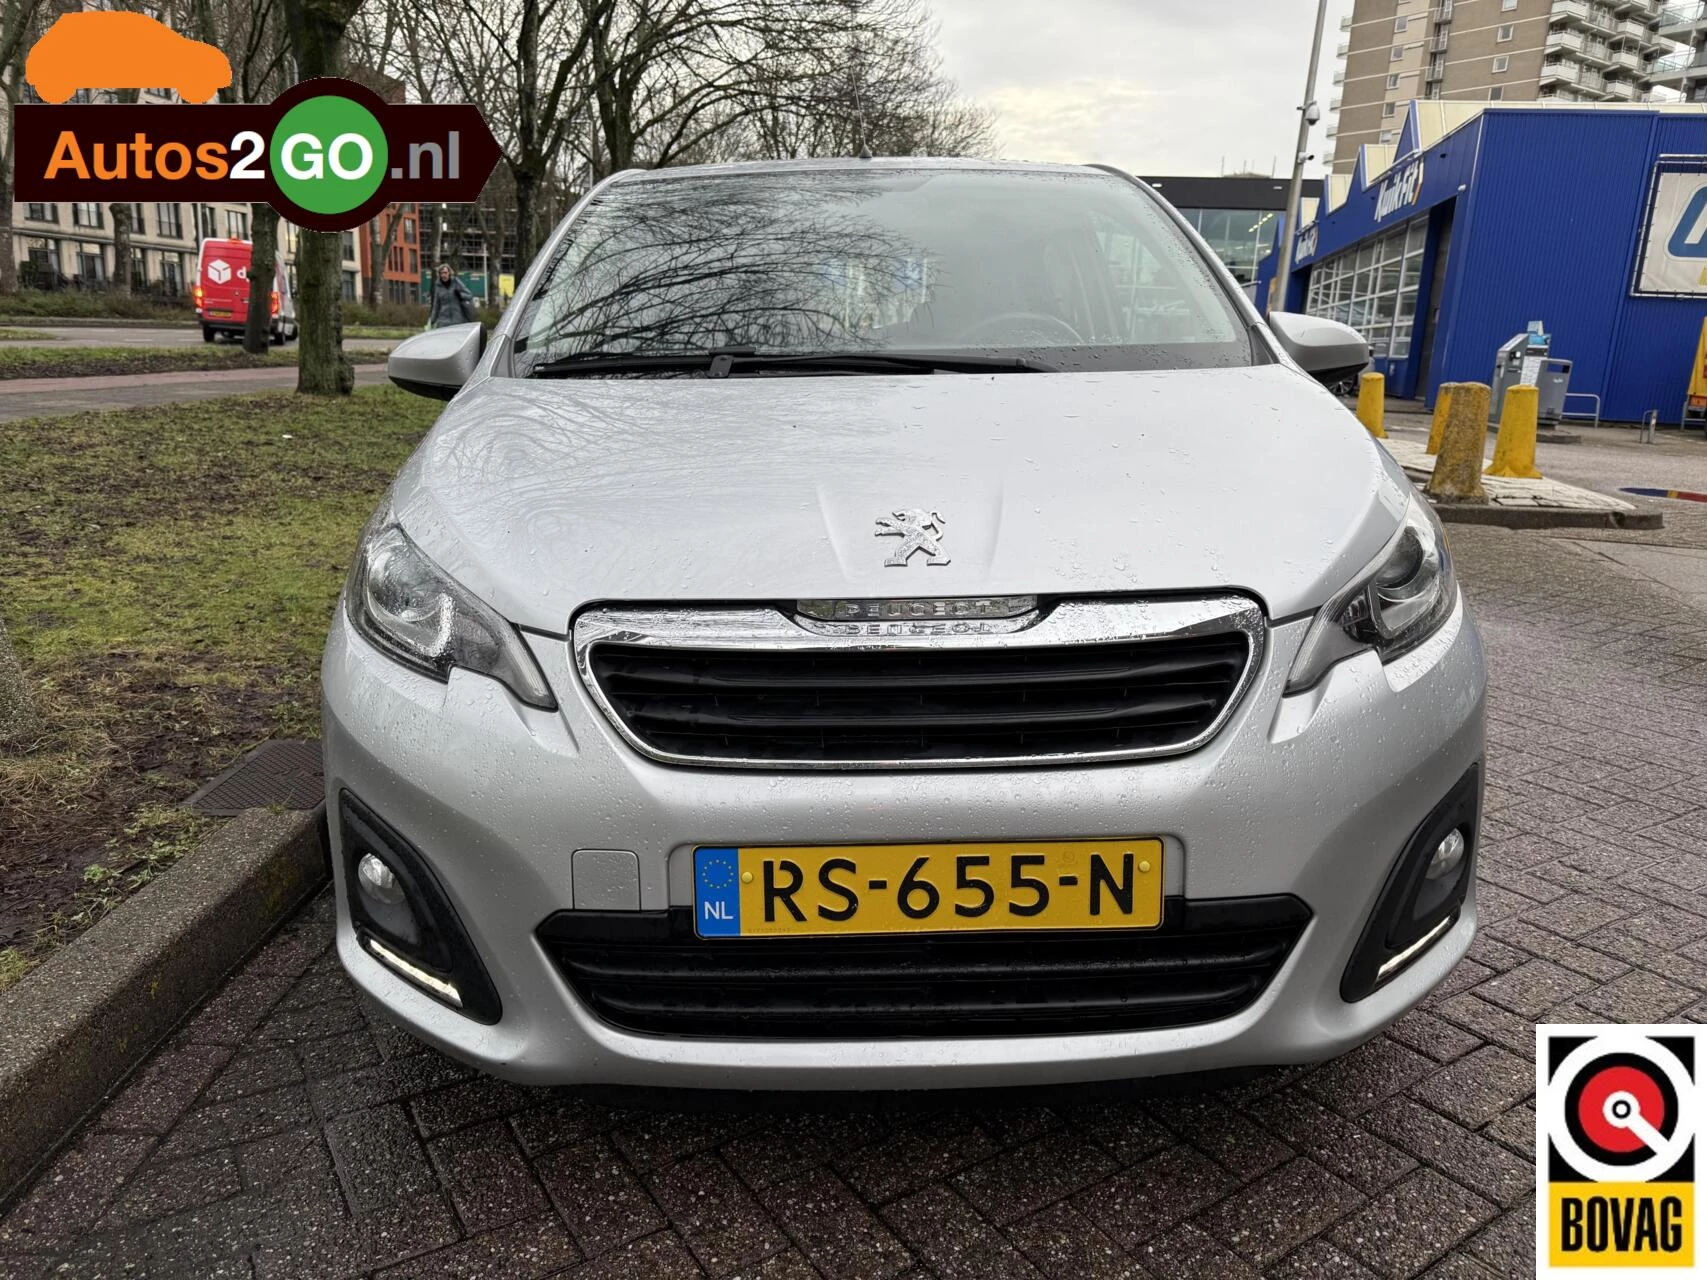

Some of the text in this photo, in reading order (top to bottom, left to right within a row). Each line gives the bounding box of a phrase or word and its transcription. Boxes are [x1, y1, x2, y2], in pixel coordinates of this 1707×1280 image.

[845, 599, 992, 617] PEUGEOT
[763, 853, 1135, 922] RS-655-N
[703, 901, 734, 920] NL
